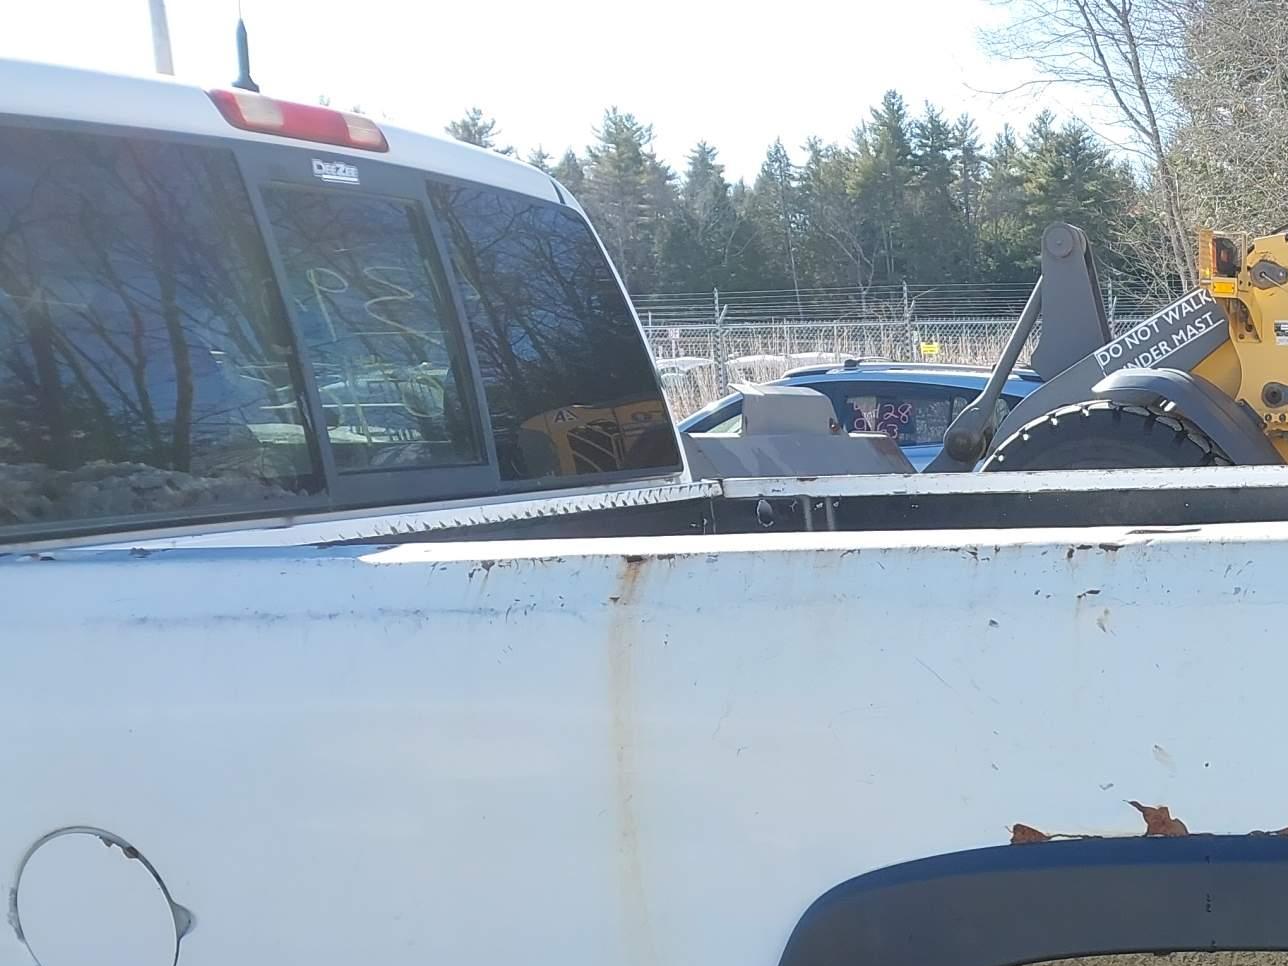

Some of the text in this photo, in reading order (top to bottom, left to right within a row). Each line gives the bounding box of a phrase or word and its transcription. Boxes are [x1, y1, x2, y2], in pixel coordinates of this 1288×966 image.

[1097, 290, 1212, 366] DO NOT WALK
[1123, 312, 1213, 369] NDER MAST
